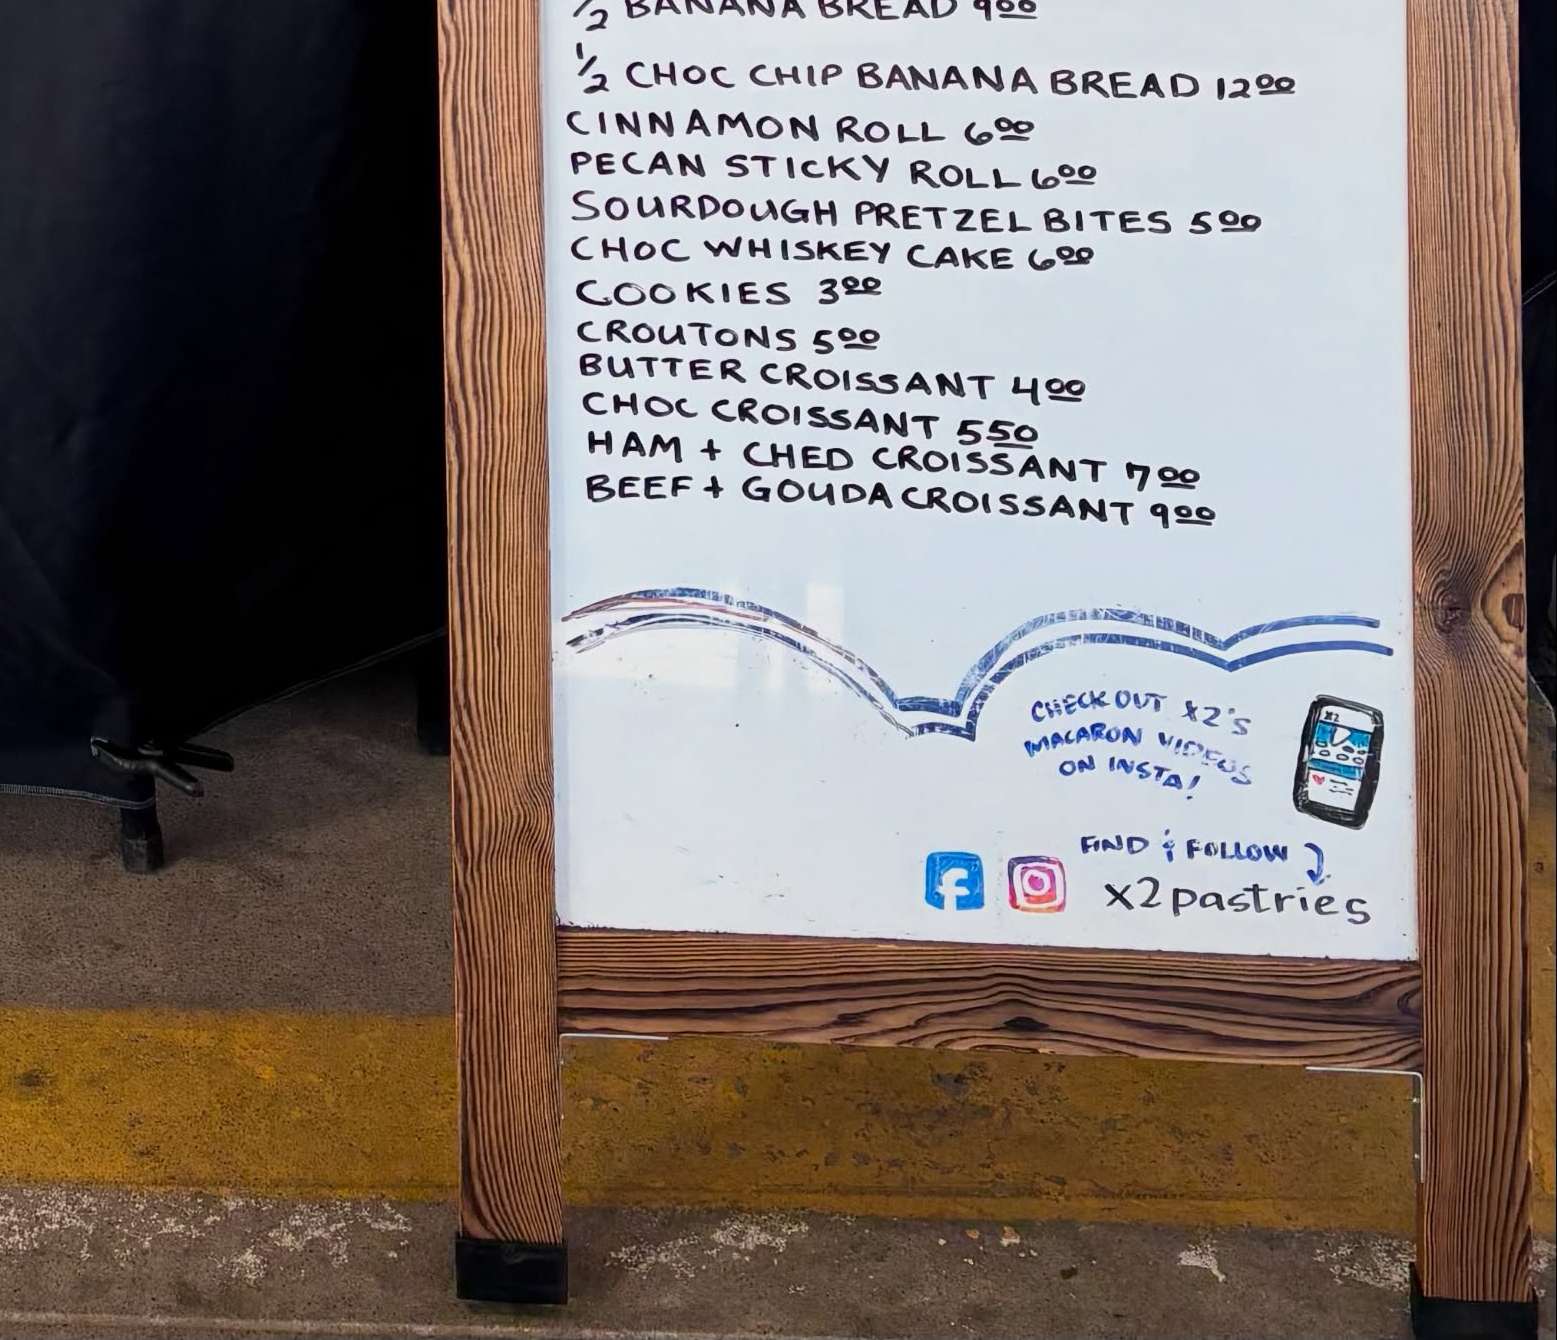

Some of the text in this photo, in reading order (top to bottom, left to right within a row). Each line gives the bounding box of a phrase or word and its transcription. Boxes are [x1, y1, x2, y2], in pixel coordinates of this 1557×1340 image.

[626, 62, 735, 88] CHOC
[750, 64, 842, 87] CHIP
[857, 62, 1038, 94] BANANA
[1051, 70, 1199, 98] BREAD
[567, 109, 819, 141] CINNAMON
[836, 116, 945, 143] ROLL
[571, 151, 705, 177] PECAN
[726, 155, 889, 183] STICKY
[910, 160, 1021, 189] ROLL
[572, 190, 837, 226] SOURDOUGH
[856, 201, 1032, 233] PRETZEL
[1044, 208, 1171, 234] BITES
[571, 236, 690, 262] CHOC
[704, 236, 890, 264] WHISKEY
[907, 245, 1013, 269] CAKE
[576, 280, 790, 306] COOKIES
[577, 320, 796, 351] CROUTONS
[580, 353, 746, 383] BUTTER
[760, 363, 995, 399] CROISSANT
[583, 392, 697, 418] CHOC
[712, 398, 939, 439] CROISSANT
[588, 431, 682, 463] HAM
[700, 439, 721, 461] +
[743, 442, 853, 471] CHED
[872, 443, 1107, 482] CROISSANT
[586, 475, 693, 502] BEEF
[703, 476, 723, 498] +
[742, 476, 893, 509] GOUDA
[901, 487, 1134, 525] CROISSANT
[1031, 690, 1110, 723] CHECK
[1115, 690, 1168, 713] OUT
[1023, 722, 1143, 757] MACARON
[1059, 755, 1201, 800] ON INSTA!
[1080, 834, 1150, 855] FIND
[1186, 838, 1289, 862] FOLLOW
